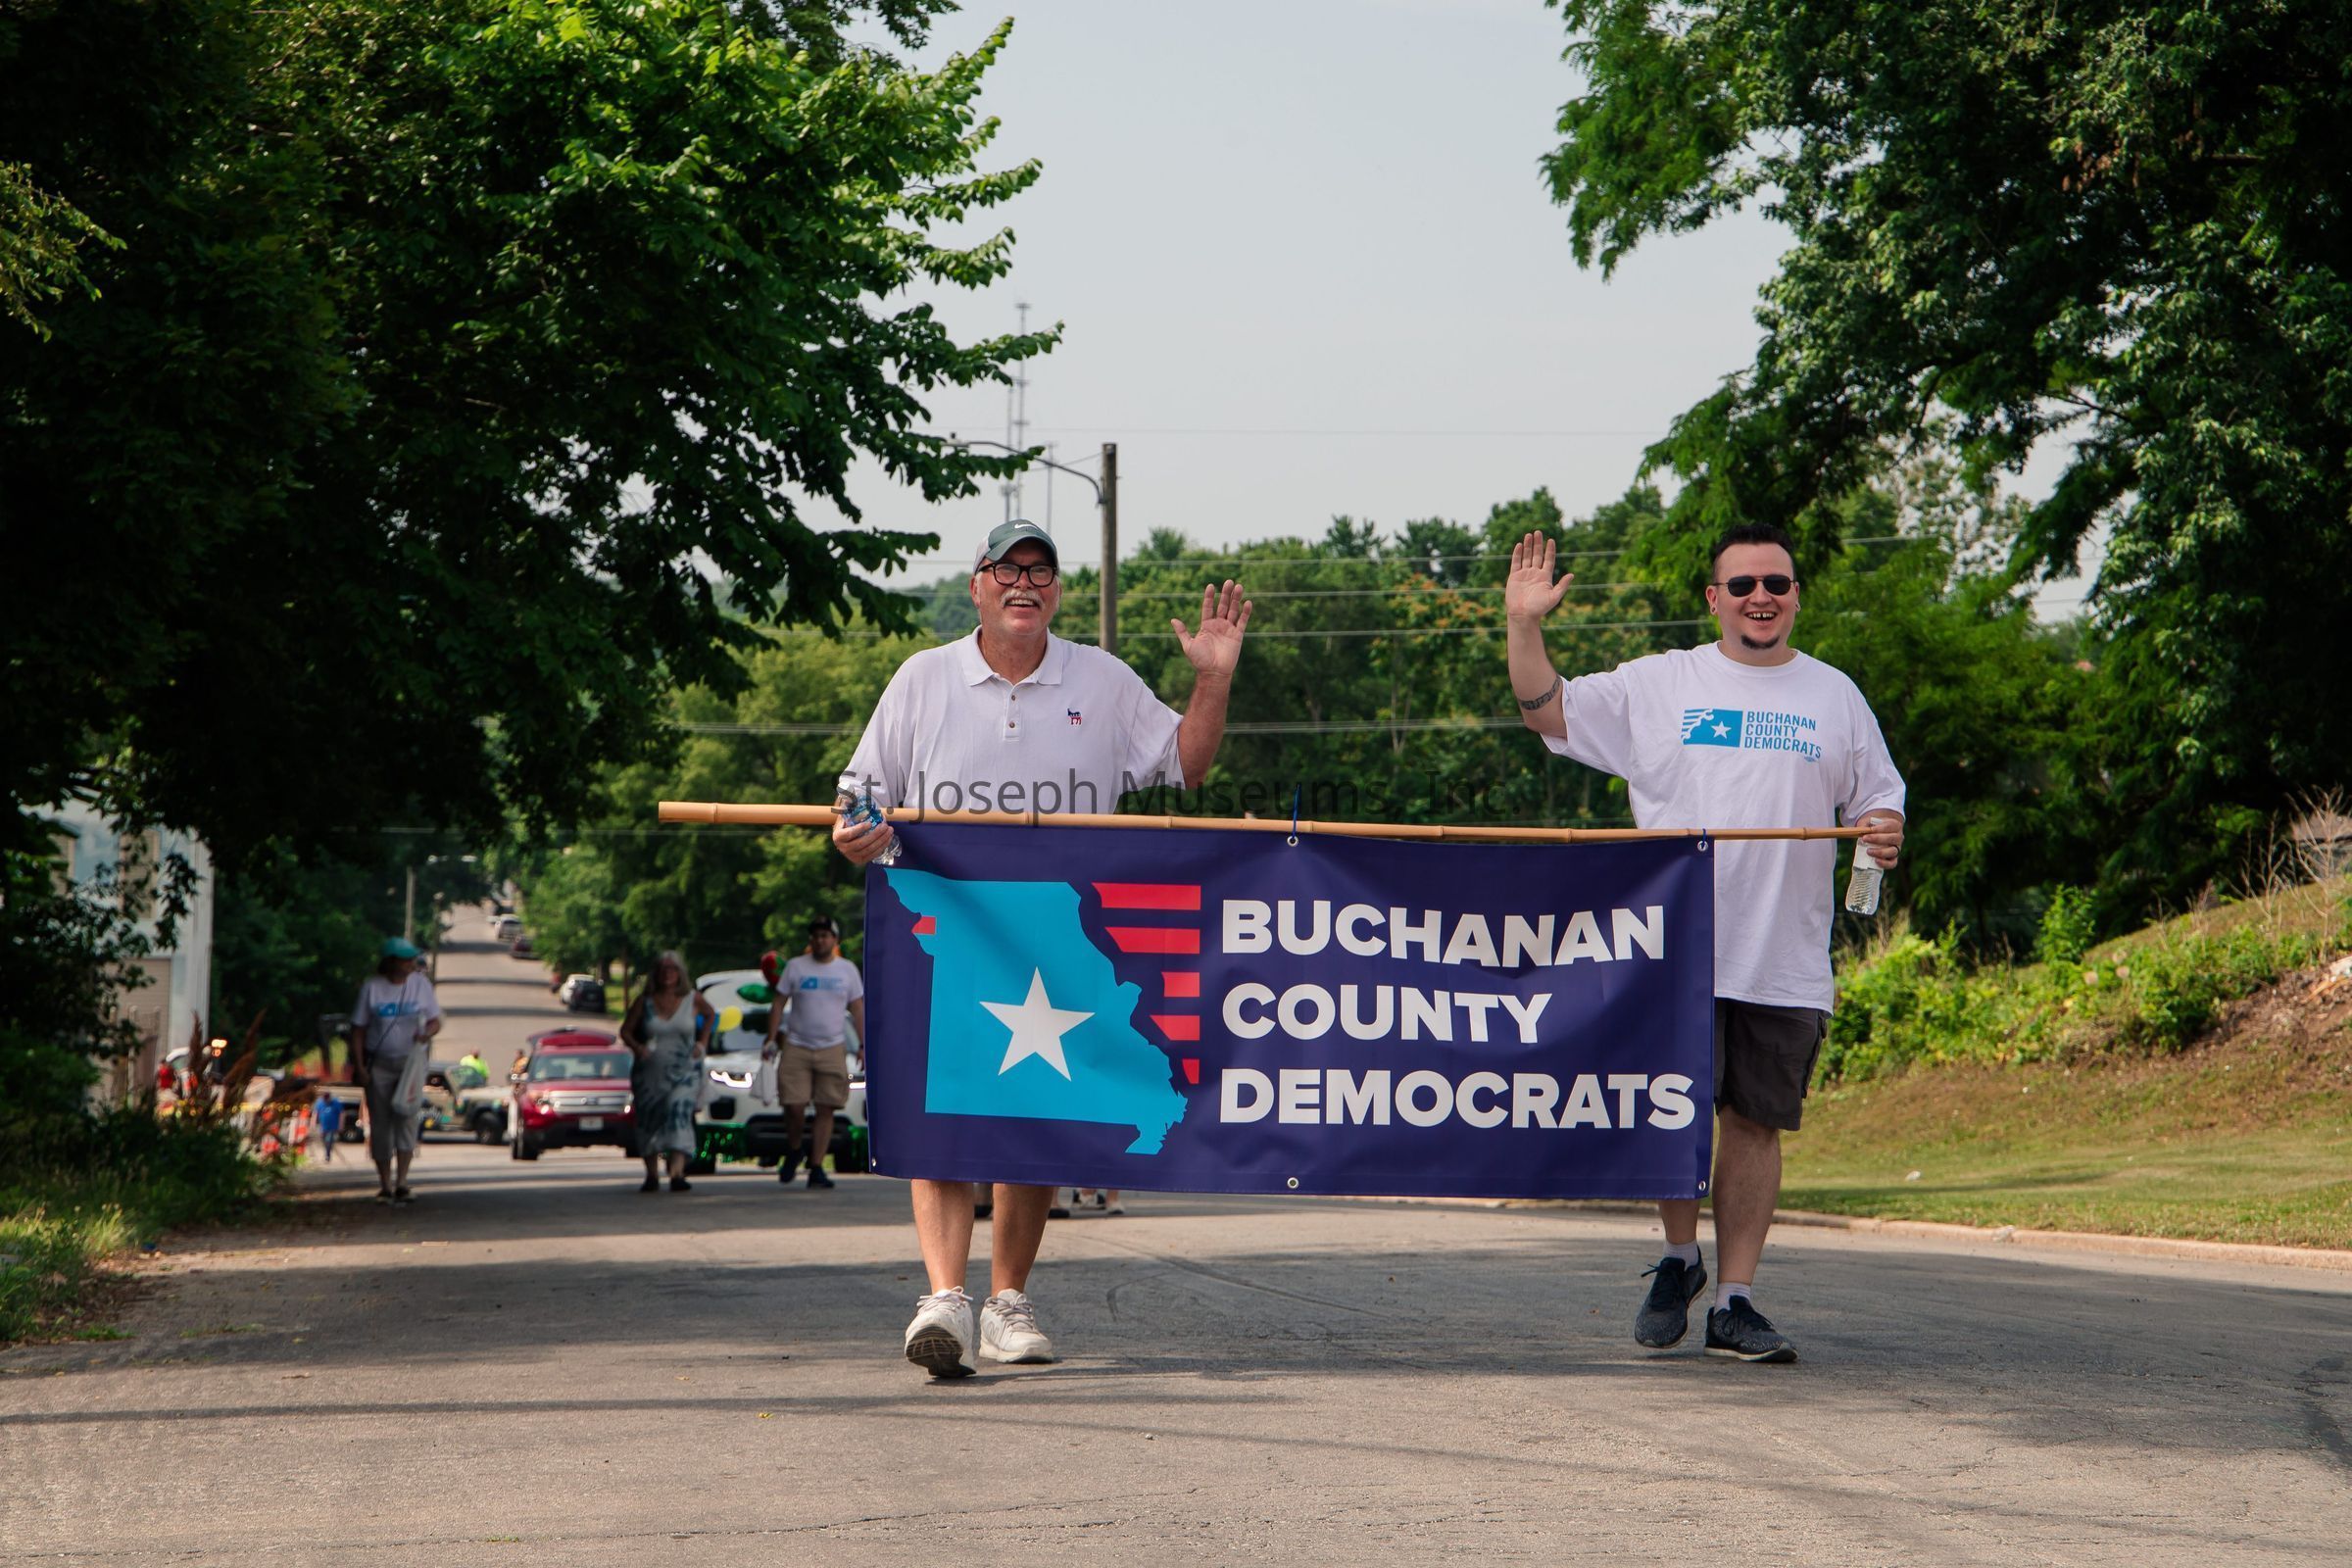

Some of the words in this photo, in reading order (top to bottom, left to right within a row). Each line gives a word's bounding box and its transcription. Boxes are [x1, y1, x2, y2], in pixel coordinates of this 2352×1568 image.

[1745, 723, 1798, 737] COUNTY
[1746, 710, 1816, 731] BUCHANAN
[1744, 736, 1822, 759] DEMOCRATS
[1222, 899, 1664, 968] BUCHANAN
[1222, 982, 1552, 1044] COUNTY
[1219, 1068, 1695, 1130] DEMOCRATS
